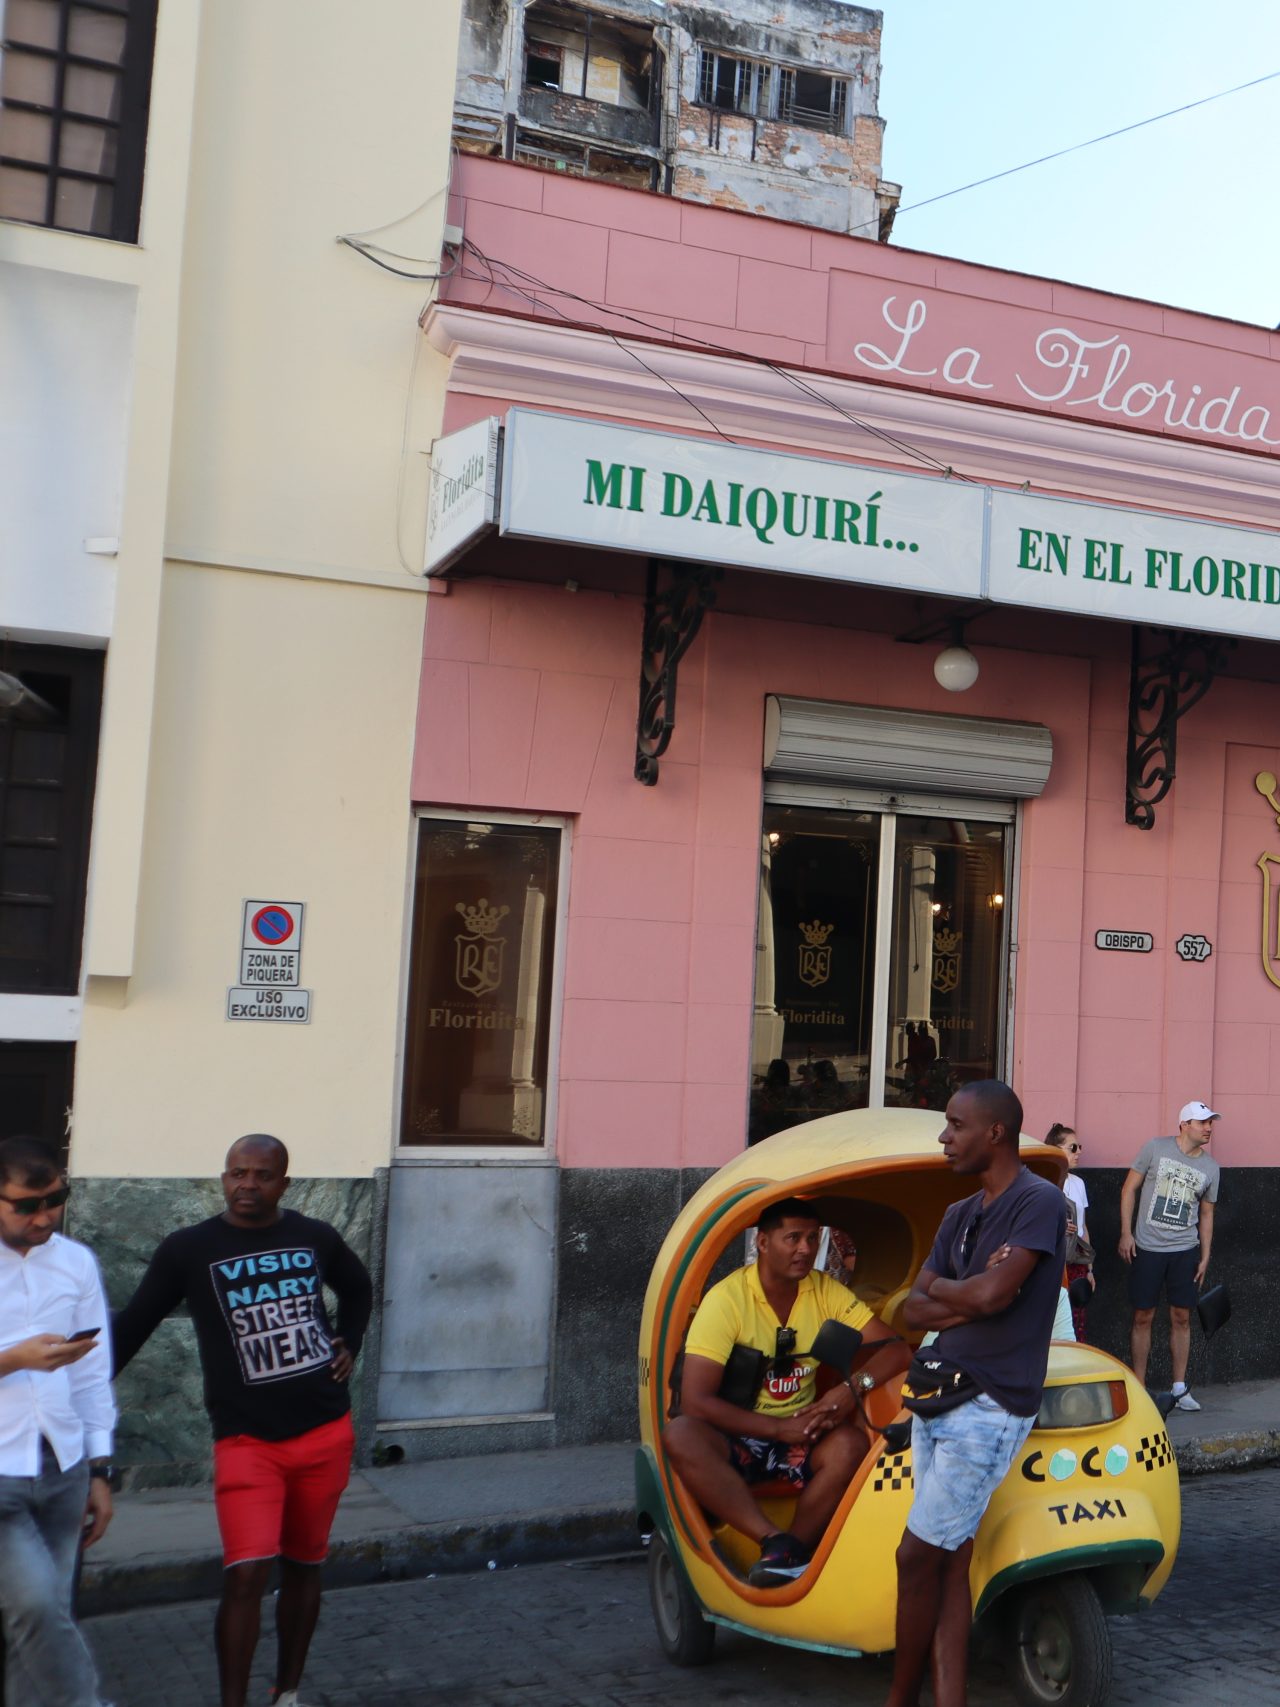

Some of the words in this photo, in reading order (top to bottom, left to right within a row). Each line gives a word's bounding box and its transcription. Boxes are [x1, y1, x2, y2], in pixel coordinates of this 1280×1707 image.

[854, 296, 993, 389] La
[1016, 328, 1280, 445] Florida
[441, 454, 484, 513] Floridita
[584, 459, 646, 512] MI
[660, 472, 919, 553] DAIQUIRÍ...
[1017, 527, 1071, 576] EN
[1082, 538, 1132, 585] EL
[1105, 934, 1144, 948] OBISPO
[1183, 940, 1205, 957] 557
[248, 954, 277, 967] ZONA
[281, 955, 294, 968] DE
[247, 968, 293, 982] PIQUERA
[256, 991, 283, 1003] USO
[231, 1004, 305, 1018] EXCLUSIVO
[428, 1008, 525, 1030] Floridita
[780, 1008, 845, 1025] Floridita
[218, 1252, 312, 1280] VISIO
[226, 1275, 318, 1309] NARY
[231, 1294, 317, 1336] STREET
[243, 1324, 327, 1373] WEAR
[769, 1377, 799, 1393] Club
[1048, 1499, 1127, 1526] TAXI
